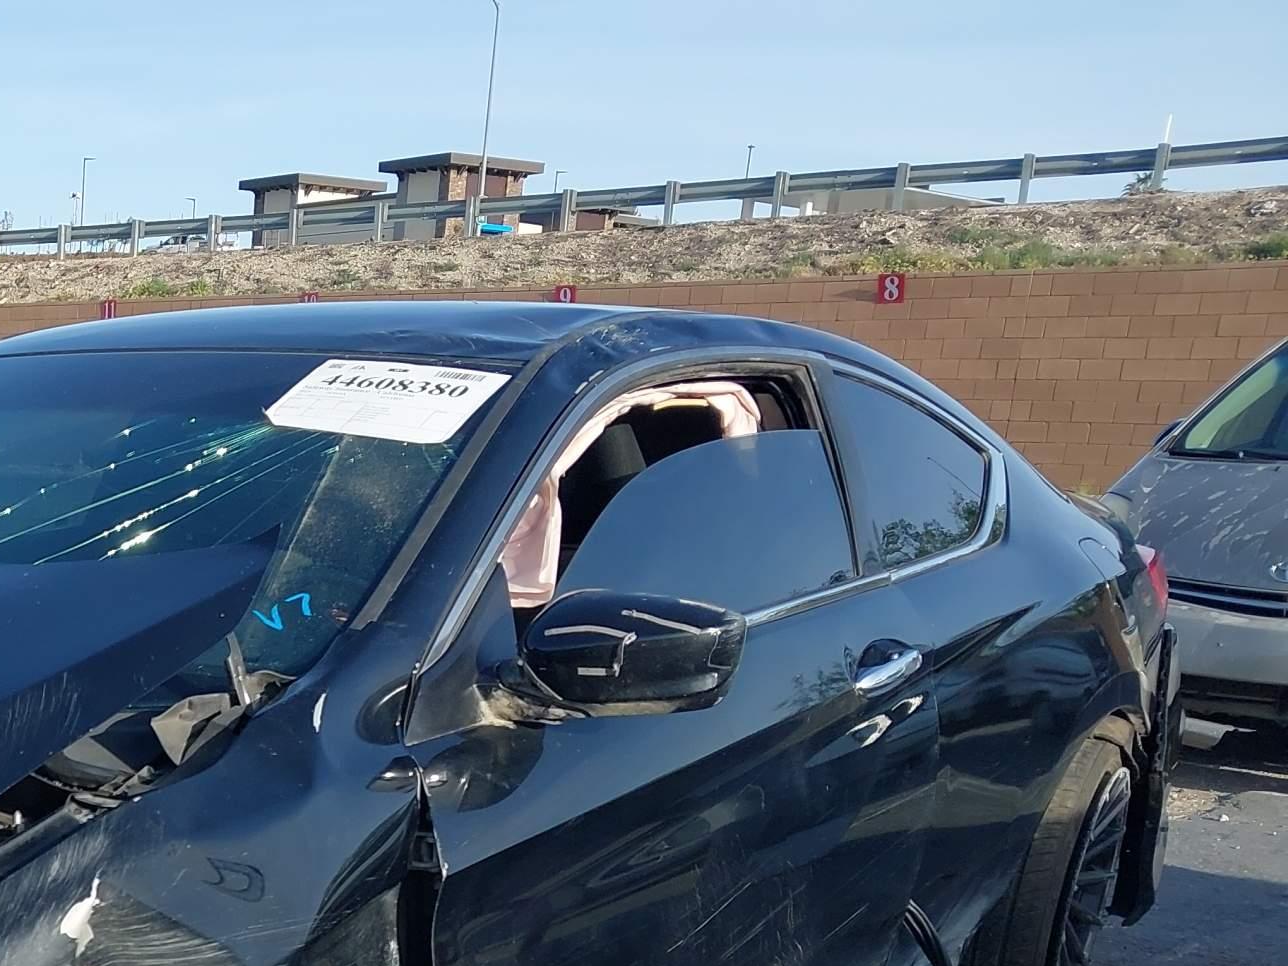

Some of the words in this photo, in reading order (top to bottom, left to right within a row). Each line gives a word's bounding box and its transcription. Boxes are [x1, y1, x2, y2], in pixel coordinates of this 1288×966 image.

[559, 287, 571, 304] 9
[883, 275, 900, 301] 8
[105, 300, 115, 319] 11
[321, 373, 470, 398] 44608380
